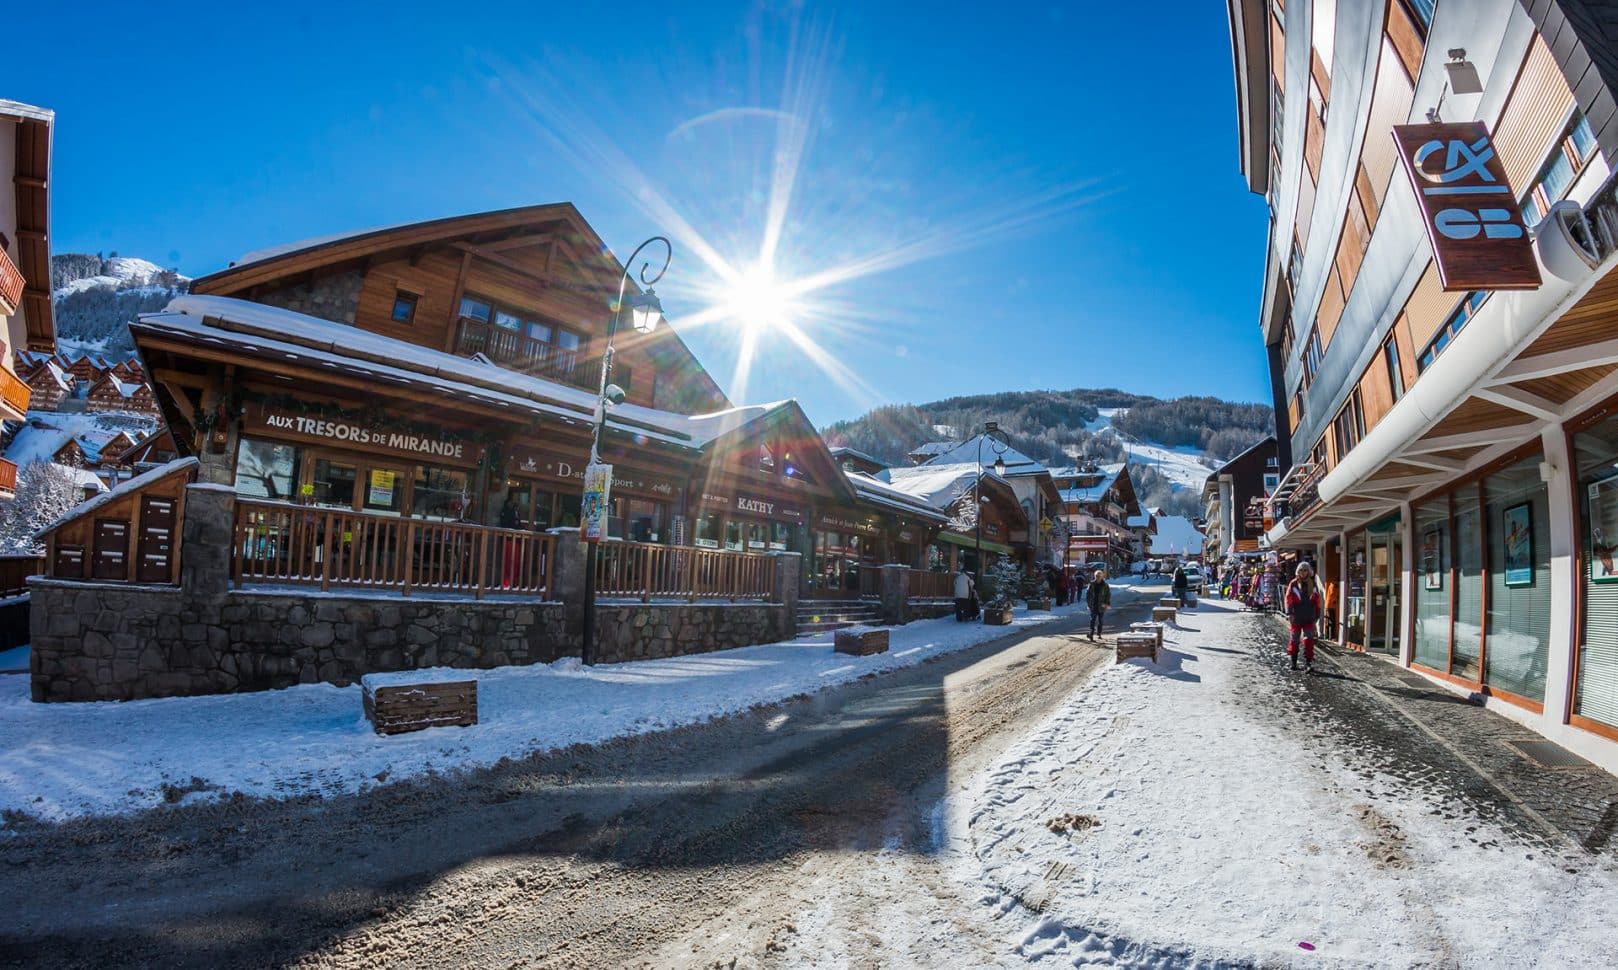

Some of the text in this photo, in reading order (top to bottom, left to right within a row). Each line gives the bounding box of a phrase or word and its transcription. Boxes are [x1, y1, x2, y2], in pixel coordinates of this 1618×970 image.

[266, 415, 462, 458] AUX TRESORS DE MIRANDE
[738, 497, 774, 514] KATHY
